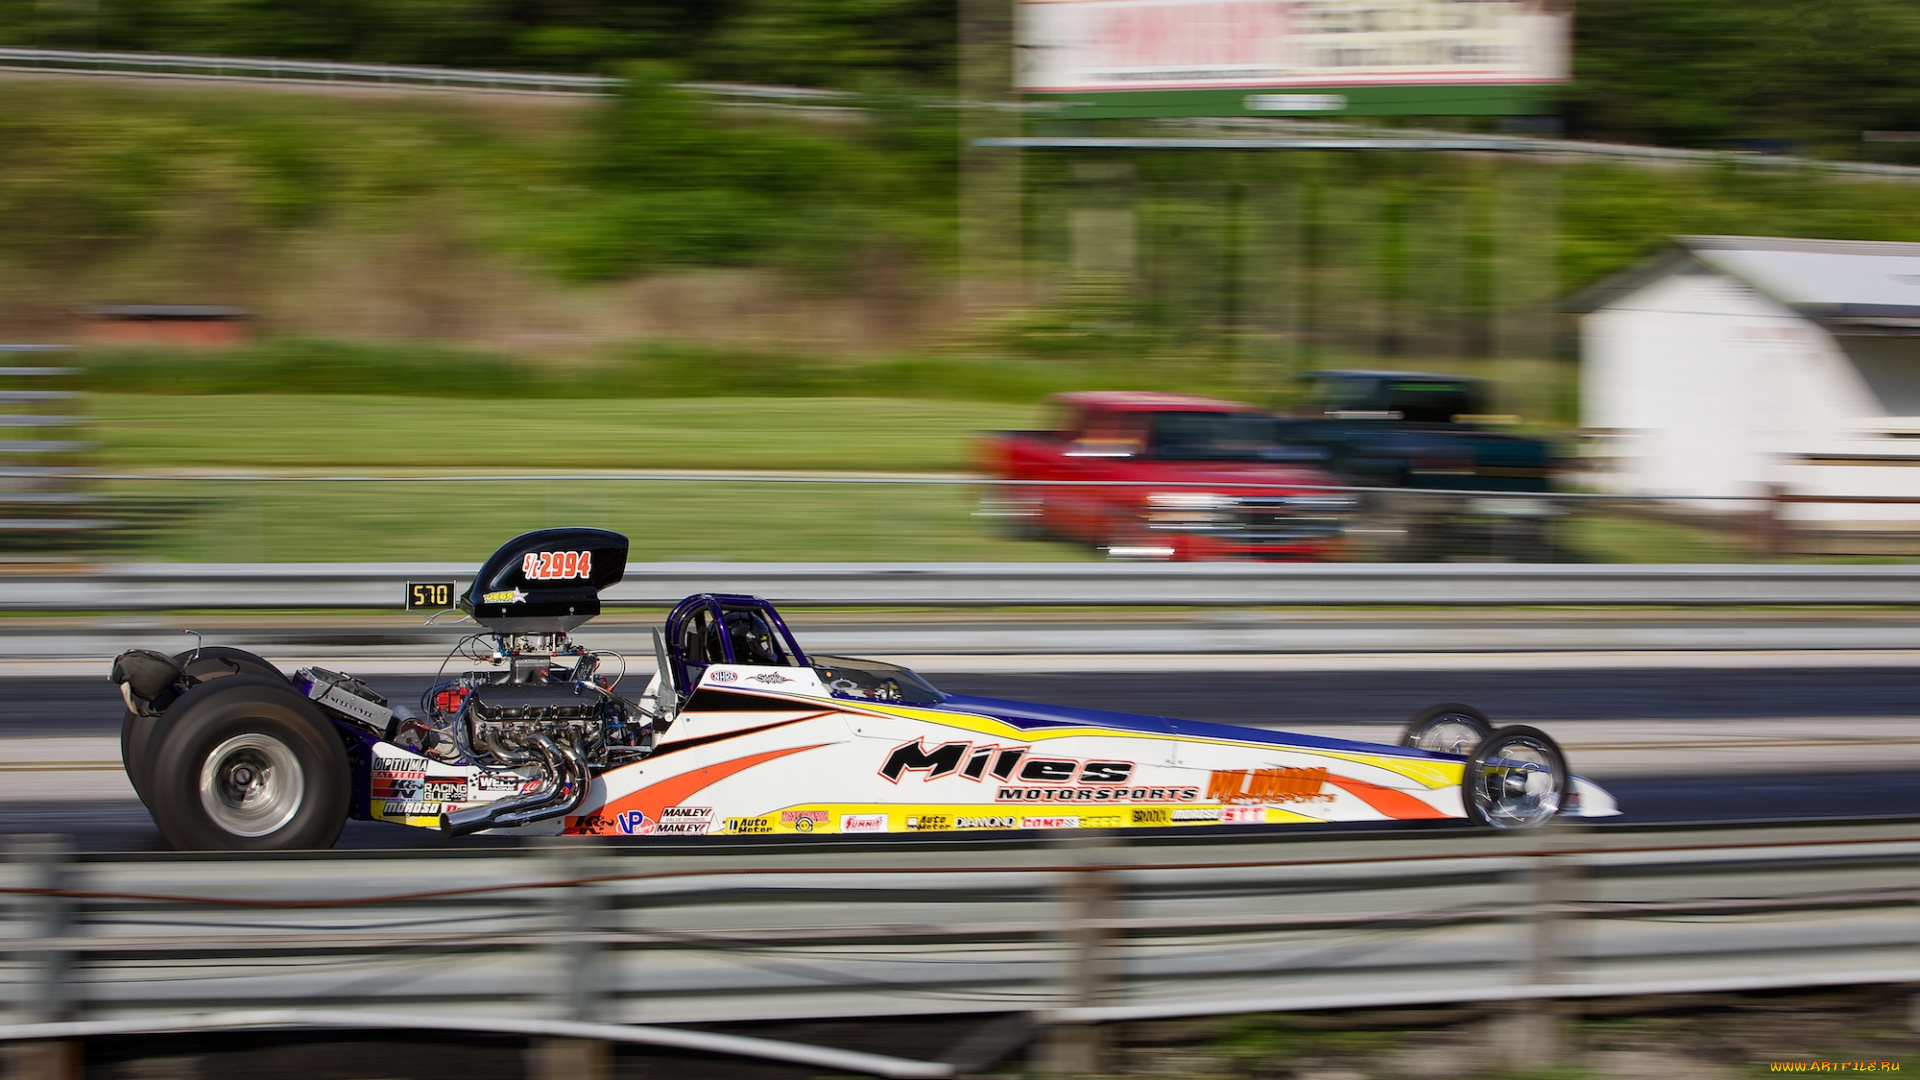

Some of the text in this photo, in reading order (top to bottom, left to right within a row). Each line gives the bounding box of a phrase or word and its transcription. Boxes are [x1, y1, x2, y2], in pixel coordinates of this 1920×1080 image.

[539, 551, 591, 579] 2994
[414, 585, 448, 605] 570
[485, 592, 514, 600] JEGS
[712, 671, 736, 681] NHRA
[374, 758, 429, 771] OPTIMA
[878, 736, 1137, 785] Miles
[480, 777, 517, 787] WELD
[424, 783, 467, 793] RACING
[996, 786, 1200, 802] MOTORSPORTS
[383, 802, 441, 816] MOROSO
[663, 808, 707, 817] MANLEY
[617, 810, 644, 834] VP
[740, 818, 767, 826] Auto
[955, 816, 1016, 828] DIAMOND
[1022, 818, 1065, 828] COMP
[657, 824, 701, 832] MANLEY
